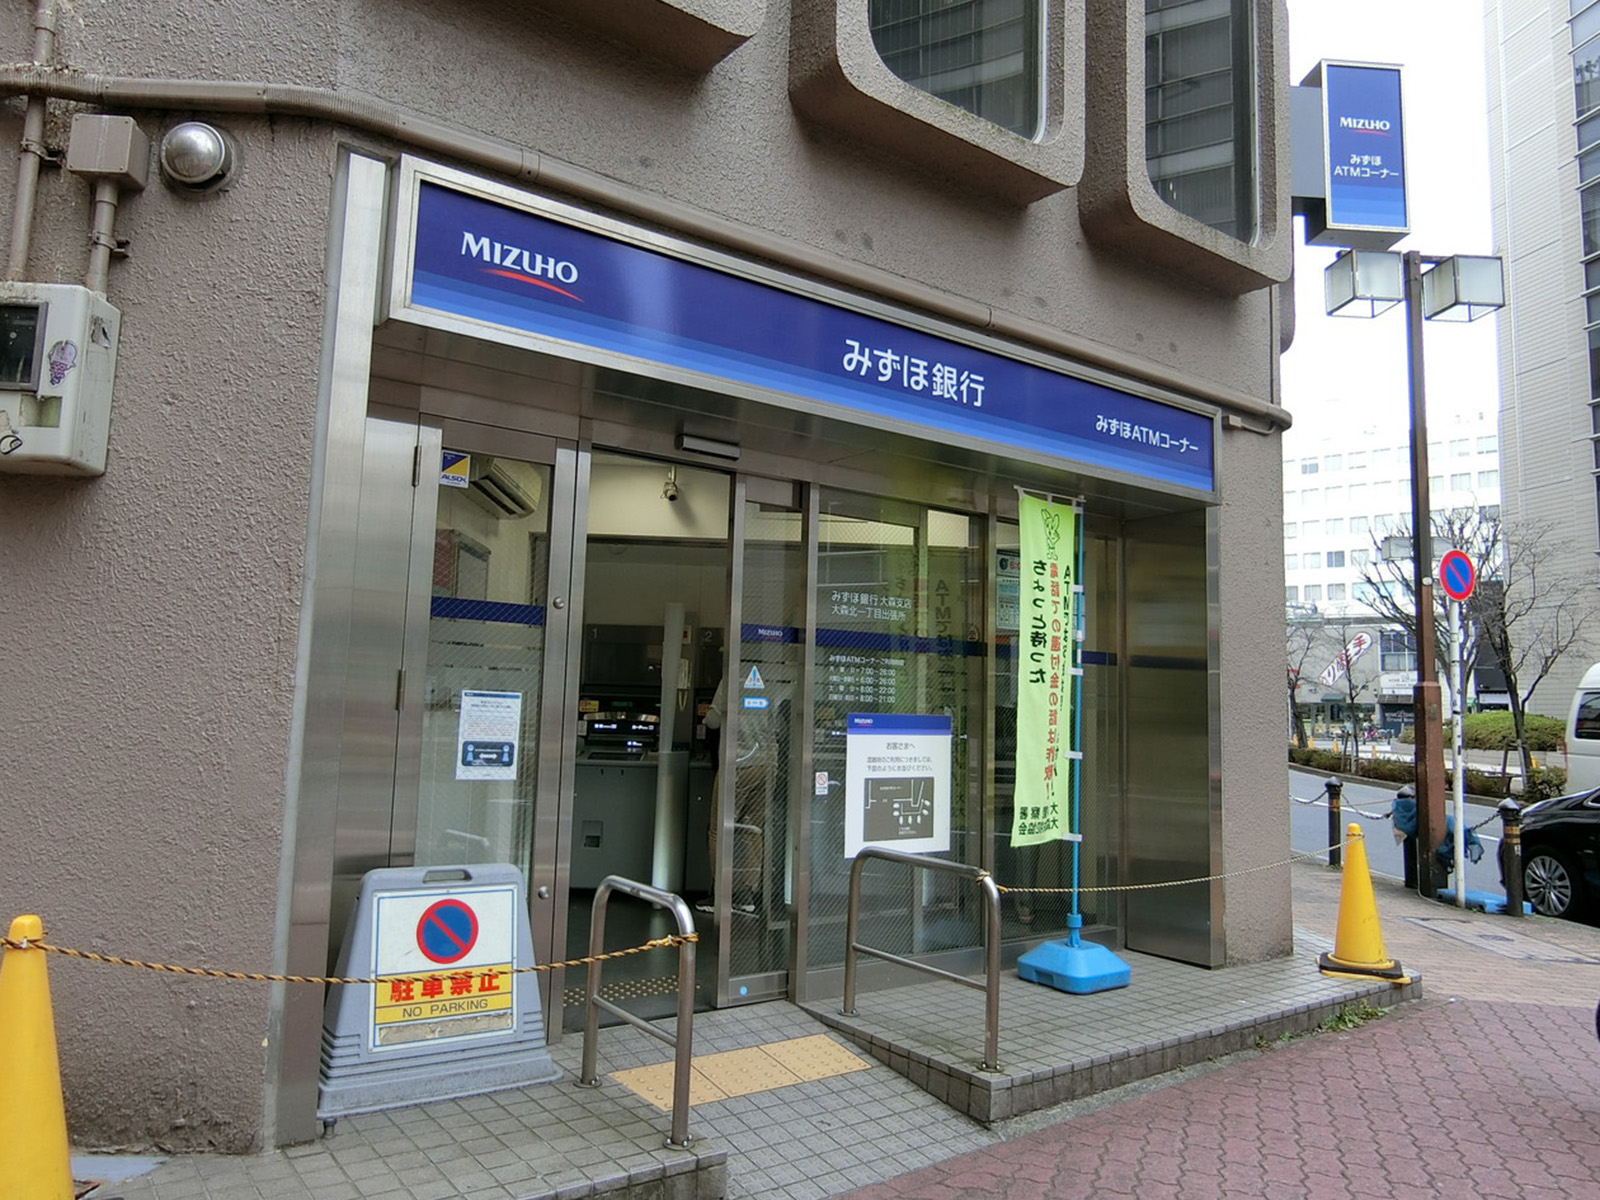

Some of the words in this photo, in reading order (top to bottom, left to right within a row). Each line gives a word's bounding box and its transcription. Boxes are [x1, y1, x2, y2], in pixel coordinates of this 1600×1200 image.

[1339, 116, 1391, 131] MIZUHO
[1349, 154, 1383, 166] みずほ
[1333, 165, 1400, 179] ATMコーナー
[461, 231, 579, 284] MIZUHO
[842, 338, 986, 408] みずほ銀行
[1095, 414, 1199, 453] みずほATMコーナー
[831, 590, 878, 606] みずほ銀行
[880, 595, 912, 609] 大森支店
[831, 603, 907, 621] 大森北一丁目出張所
[758, 628, 783, 637] MIZUHO
[854, 717, 874, 725] MIZUHO
[390, 969, 499, 1002] 駐車禁止
[403, 1006, 422, 1018] NO
[430, 999, 488, 1014] PARKING
